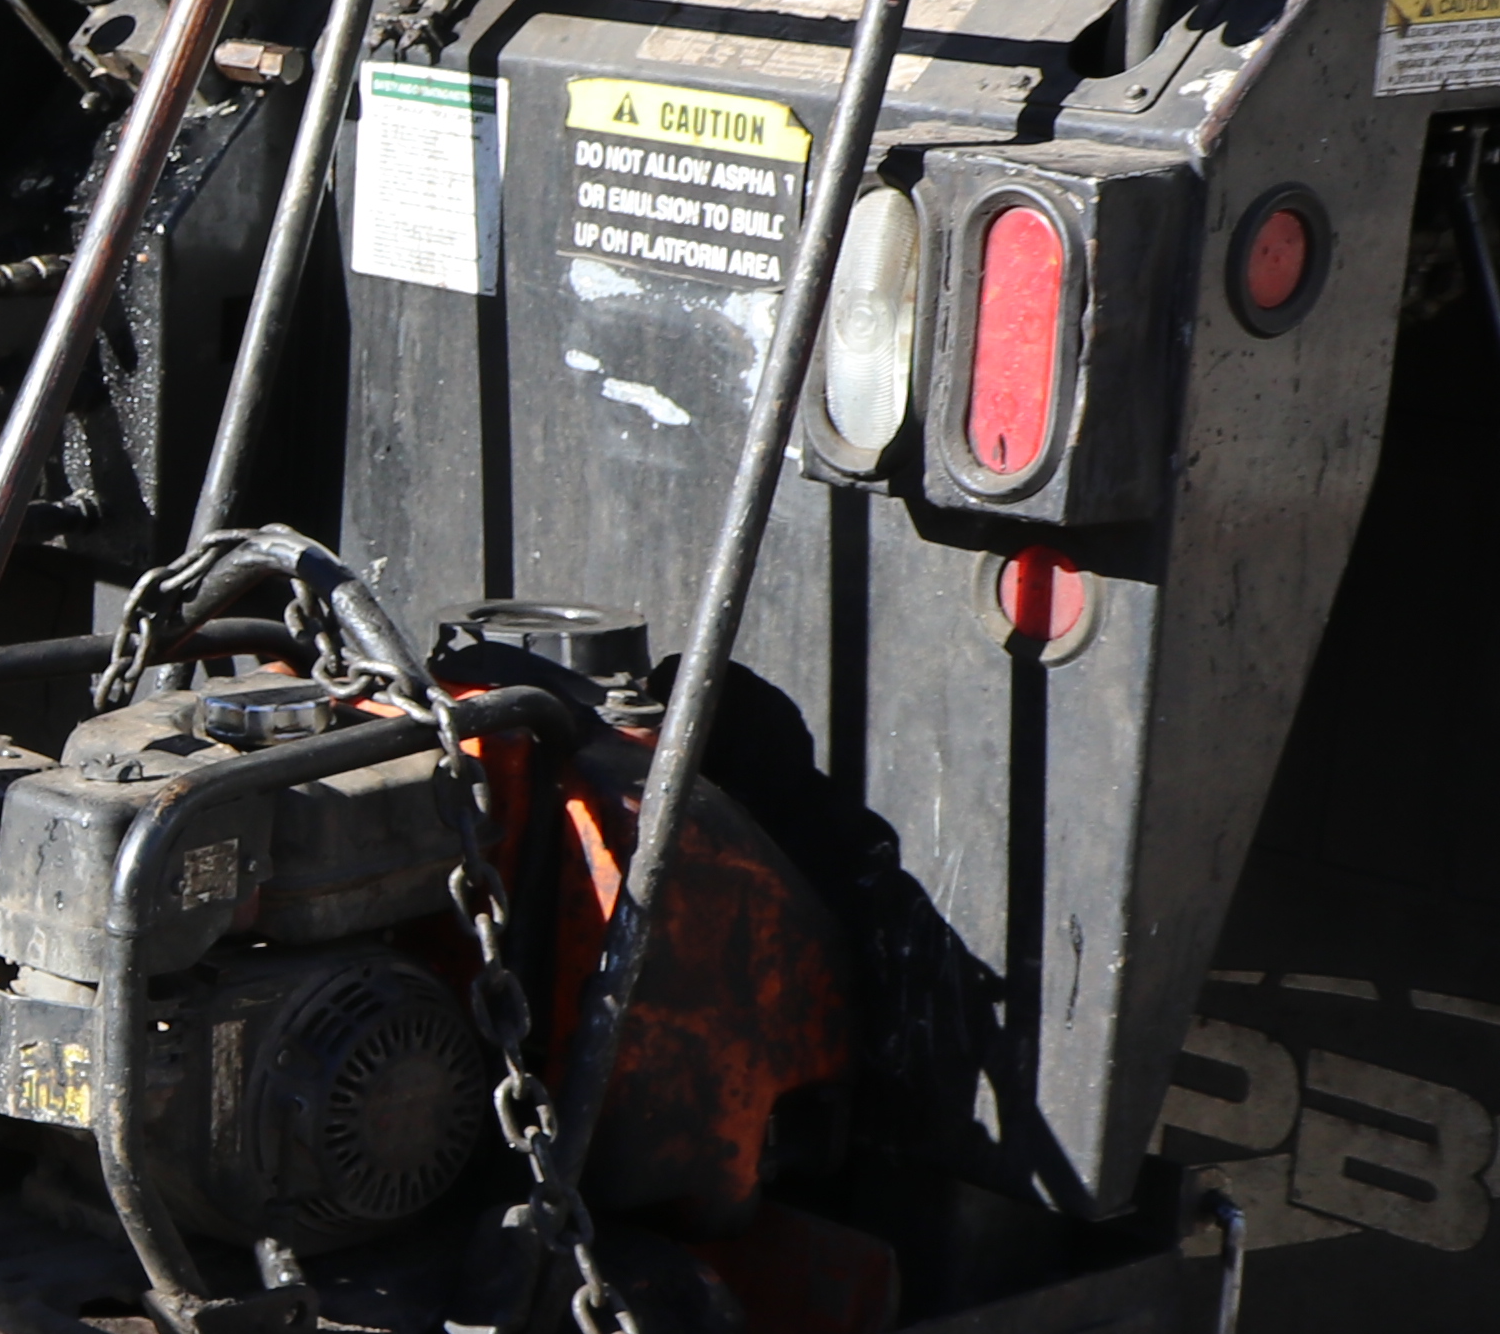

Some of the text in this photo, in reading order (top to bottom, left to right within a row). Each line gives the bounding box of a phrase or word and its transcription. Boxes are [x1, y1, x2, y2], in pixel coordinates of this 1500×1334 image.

[660, 101, 766, 145] CAUTION
[575, 140, 796, 197] DO NOT ALLOW ASPHAT
[578, 181, 606, 210] OR
[608, 187, 701, 227] EMULSION
[702, 201, 729, 231] TO
[574, 221, 781, 282] UP ON PLATFORM AREA
